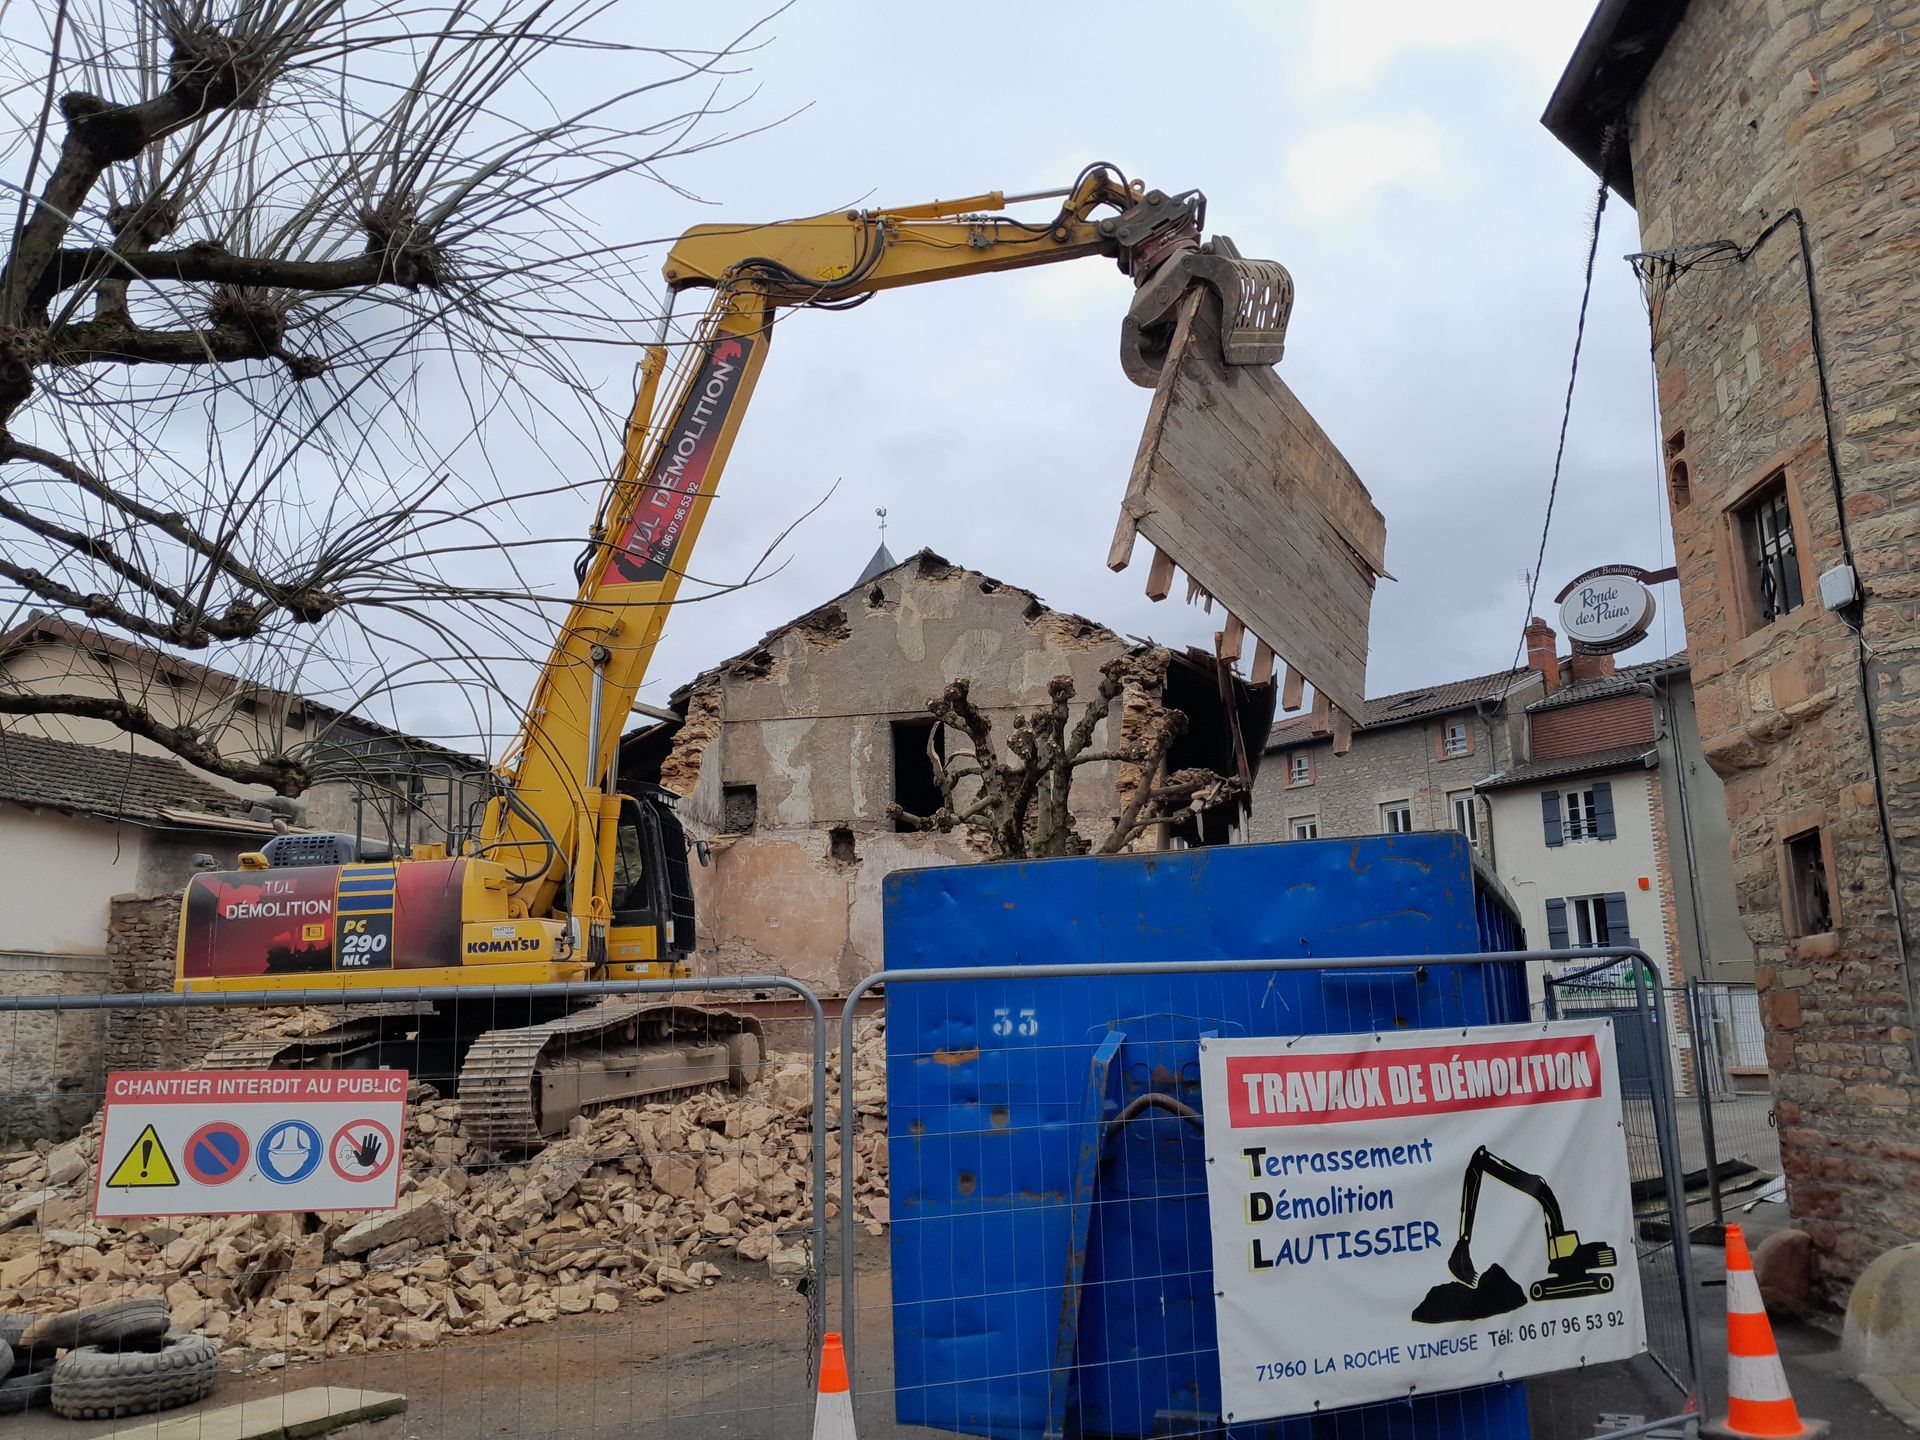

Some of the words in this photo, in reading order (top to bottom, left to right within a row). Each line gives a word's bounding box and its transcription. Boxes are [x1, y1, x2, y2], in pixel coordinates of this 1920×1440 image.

[626, 517, 660, 553] TDL
[651, 361, 736, 509] DÉMOLITION
[686, 481, 699, 495] 92
[680, 494, 693, 508] 53
[674, 507, 686, 521] 96
[667, 520, 680, 534] 07
[661, 533, 674, 547] 06
[1601, 565, 1642, 577] Boulanger
[1579, 586, 1619, 608] Ronde
[1575, 612, 1595, 625] des
[1593, 602, 1630, 624] Pains
[264, 880, 295, 894] TDL
[225, 899, 331, 920] DÉMOLITION
[343, 919, 367, 934] PC
[341, 933, 387, 953] 290
[467, 936, 540, 953] KOMATSU
[342, 954, 371, 966] NLC
[114, 1078, 212, 1096] CHANTIER
[216, 1078, 302, 1095] INTERDIT
[304, 1077, 333, 1094] AU
[336, 1077, 401, 1094] PUBLIC
[1242, 1066, 1386, 1115] TRAVAUX
[1387, 1064, 1428, 1106] DE
[1429, 1050, 1593, 1104] DÉMOLITION
[1242, 1137, 1433, 1178] Terrassement
[1247, 1184, 1394, 1223] Démolition
[1250, 1220, 1442, 1270] LAUTISSIER
[1255, 1359, 1307, 1382] 71960
[1313, 1357, 1337, 1375] LA
[1343, 1346, 1401, 1371] ROCHE
[1406, 1334, 1479, 1361] VINEUSE
[1518, 1324, 1538, 1341] 06
[1541, 1320, 1557, 1338] 07
[1561, 1316, 1581, 1334] 96
[1585, 1313, 1603, 1330] 53
[1607, 1310, 1625, 1328] 92
